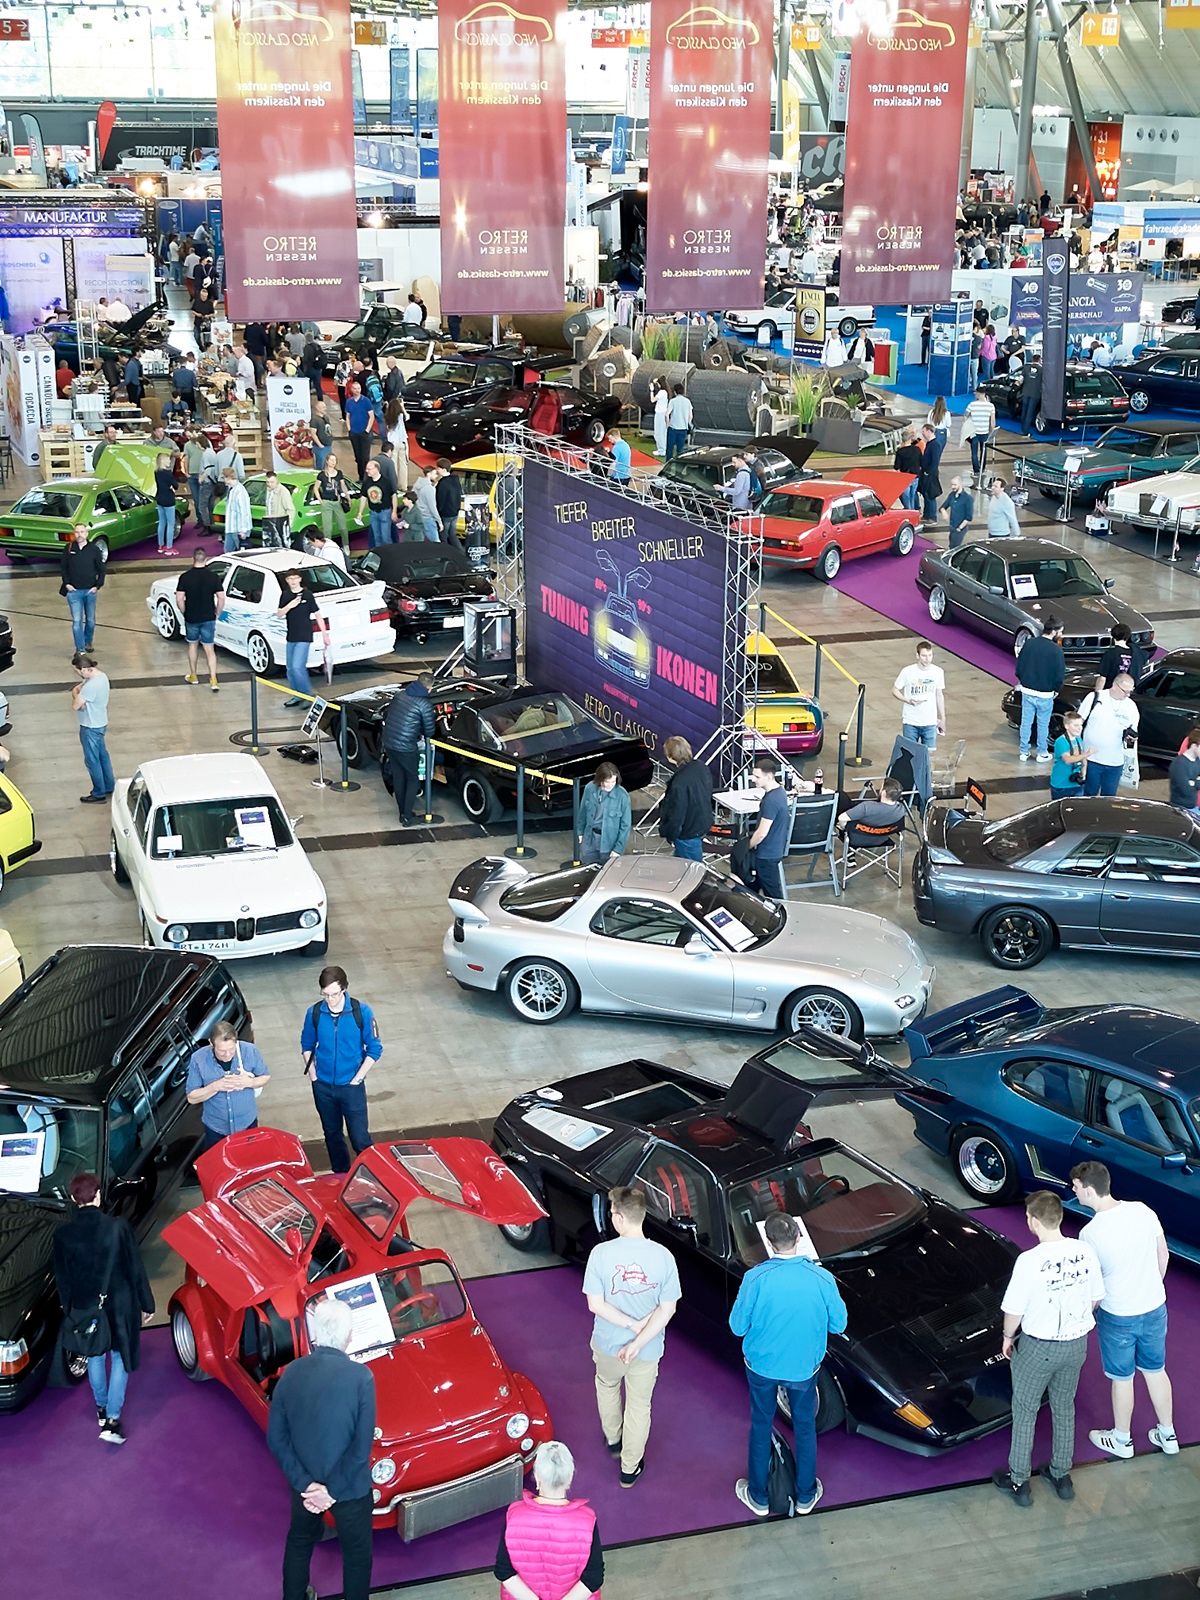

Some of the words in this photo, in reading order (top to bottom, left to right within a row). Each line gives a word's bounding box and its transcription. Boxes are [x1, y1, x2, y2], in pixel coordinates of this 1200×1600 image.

[2, 20, 12, 34] 5
[838, 64, 847, 92] BOSCH
[24, 212, 108, 223] MANUFAKTUR
[1022, 282, 1039, 294] 40
[1116, 279, 1133, 292] 30
[1068, 296, 1096, 307] ANCIA
[25, 392, 36, 424] FOCACCIA
[554, 502, 588, 524] TIEFER
[592, 517, 636, 542] BREITER
[638, 536, 704, 562] SCHNELLER
[540, 584, 589, 636] TUNING
[656, 645, 718, 706] IKONEN
[584, 692, 612, 724] RETRO
